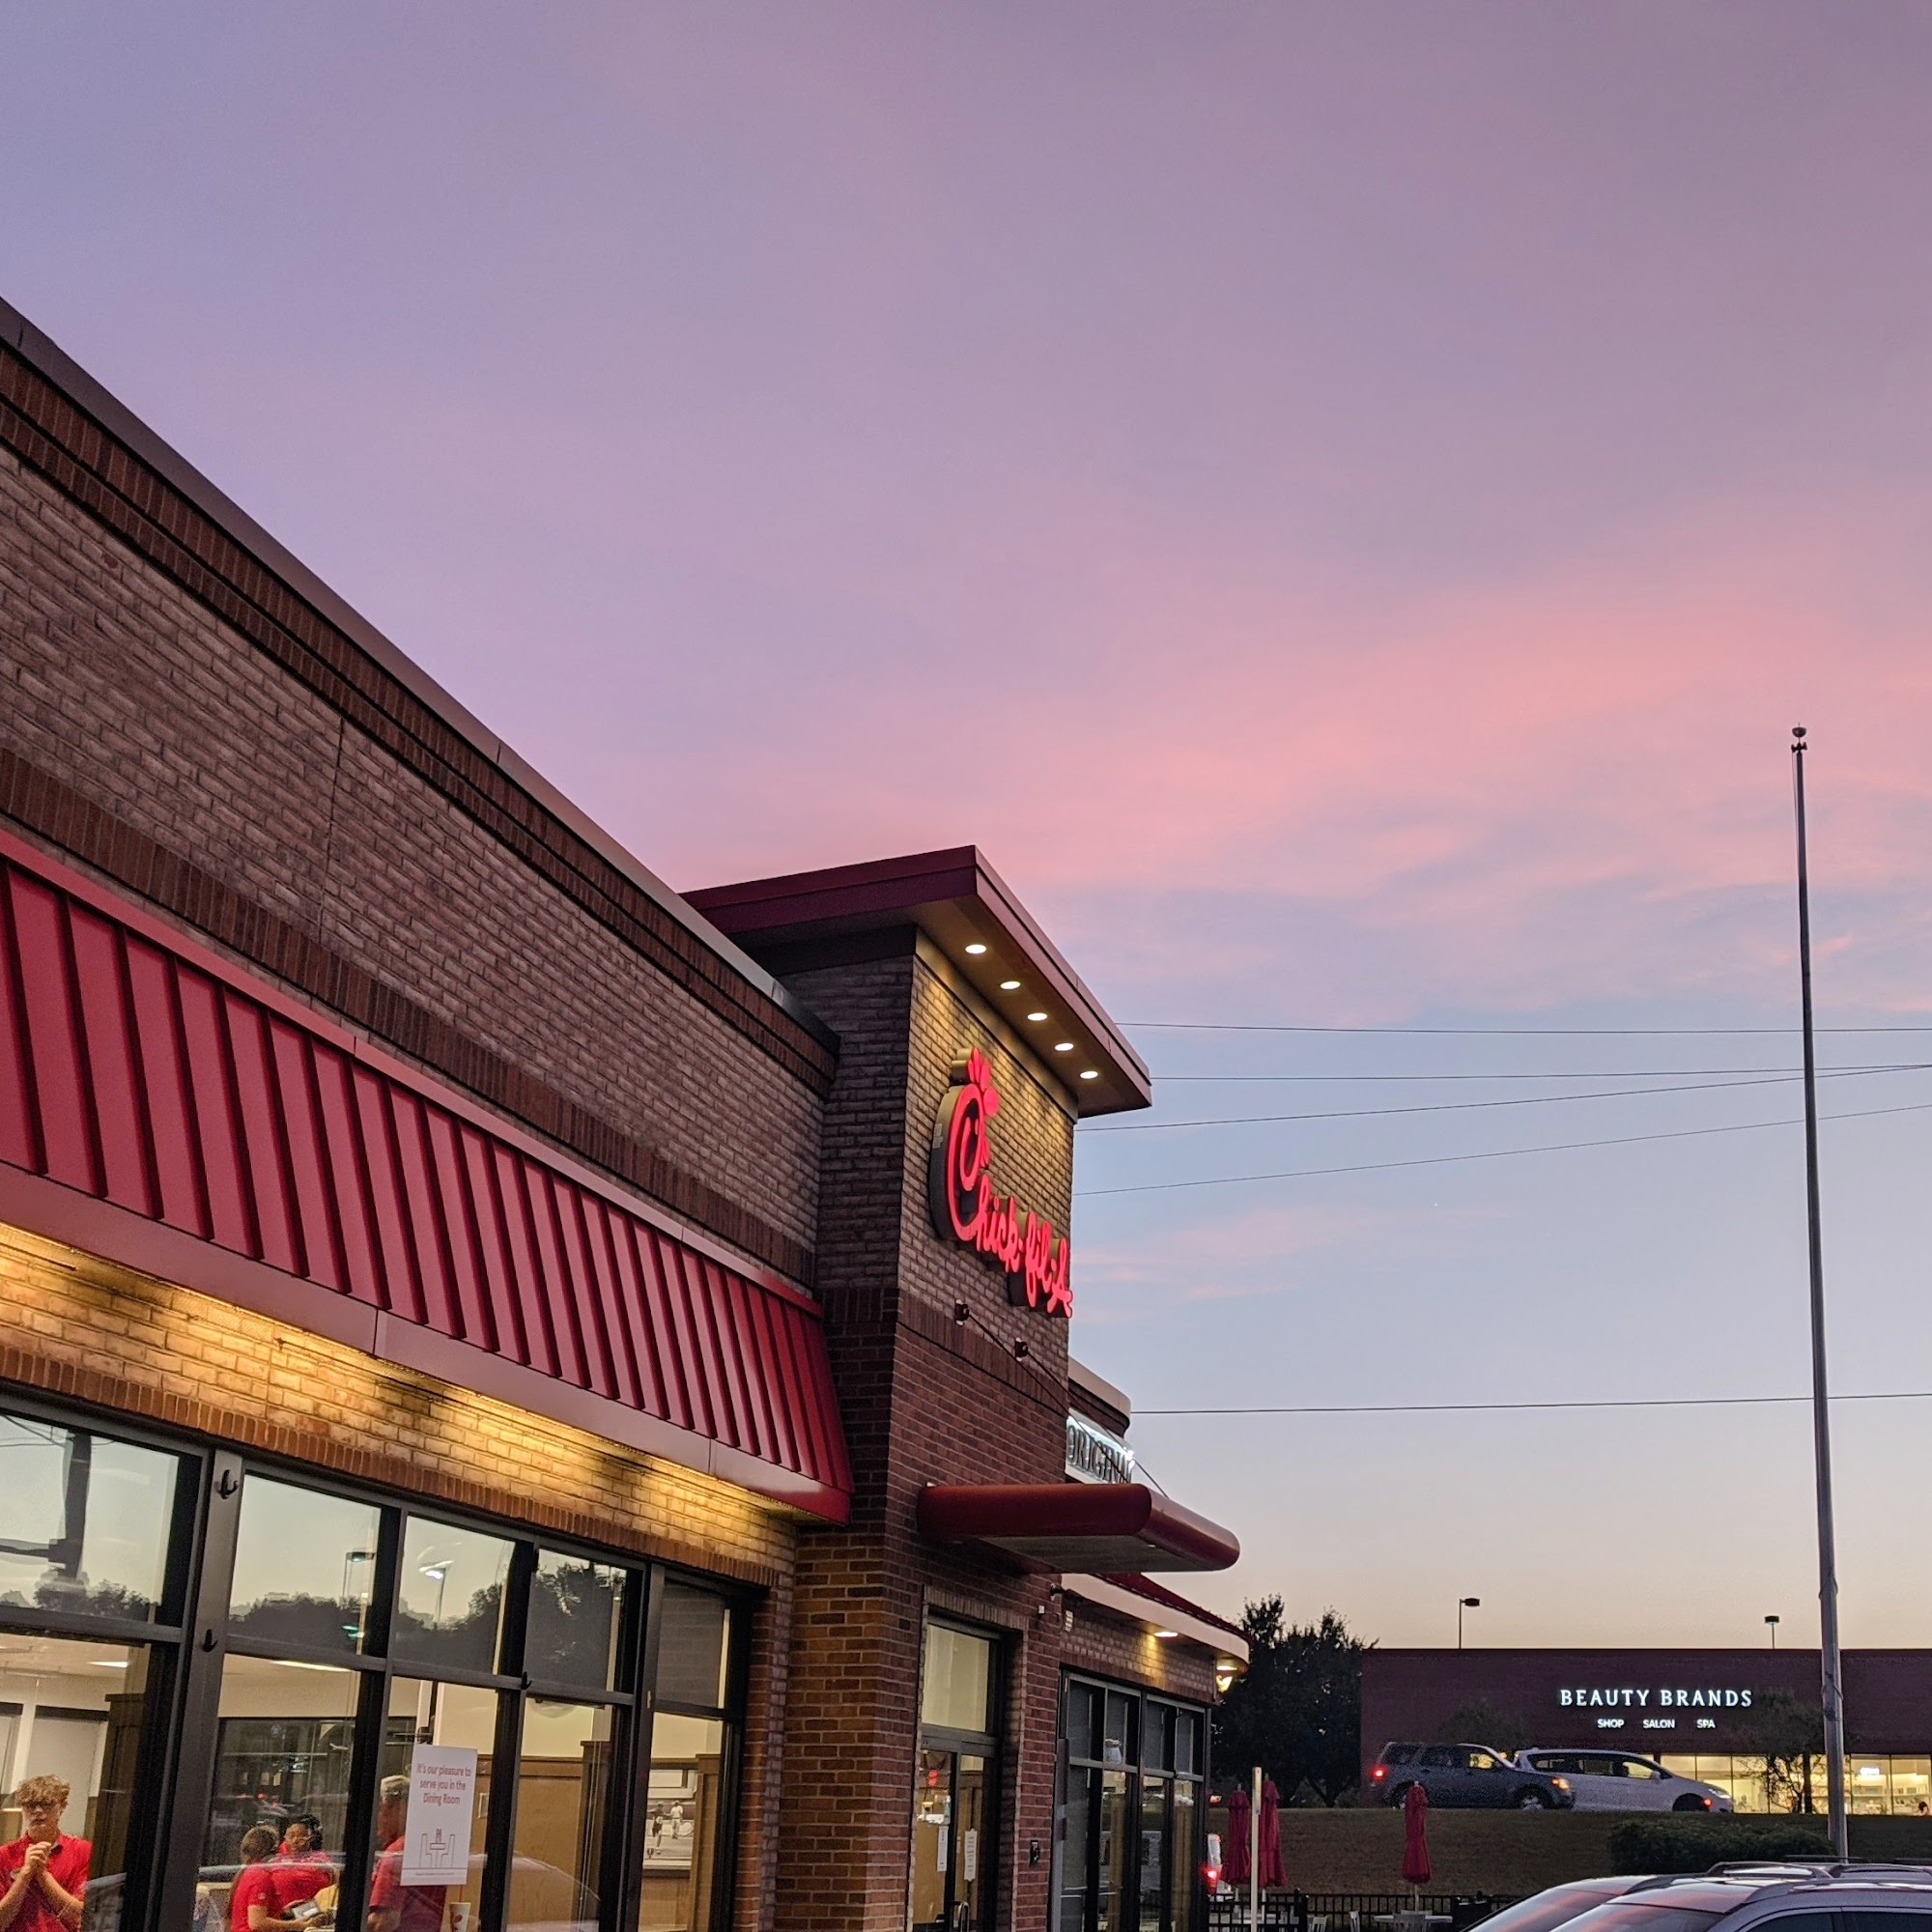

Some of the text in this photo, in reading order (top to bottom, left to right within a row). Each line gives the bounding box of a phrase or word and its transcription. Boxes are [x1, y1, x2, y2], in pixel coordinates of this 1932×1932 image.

[1560, 1689, 1752, 1707] BEAUTY BRANDS
[1597, 1719, 1716, 1729] SHOP SALON SPA
[427, 1766, 438, 1775] our
[439, 1765, 464, 1776] pleasure
[465, 1767, 471, 1776] to
[420, 1779, 467, 1791] serve you in the
[423, 1793, 461, 1806] Dining Room
